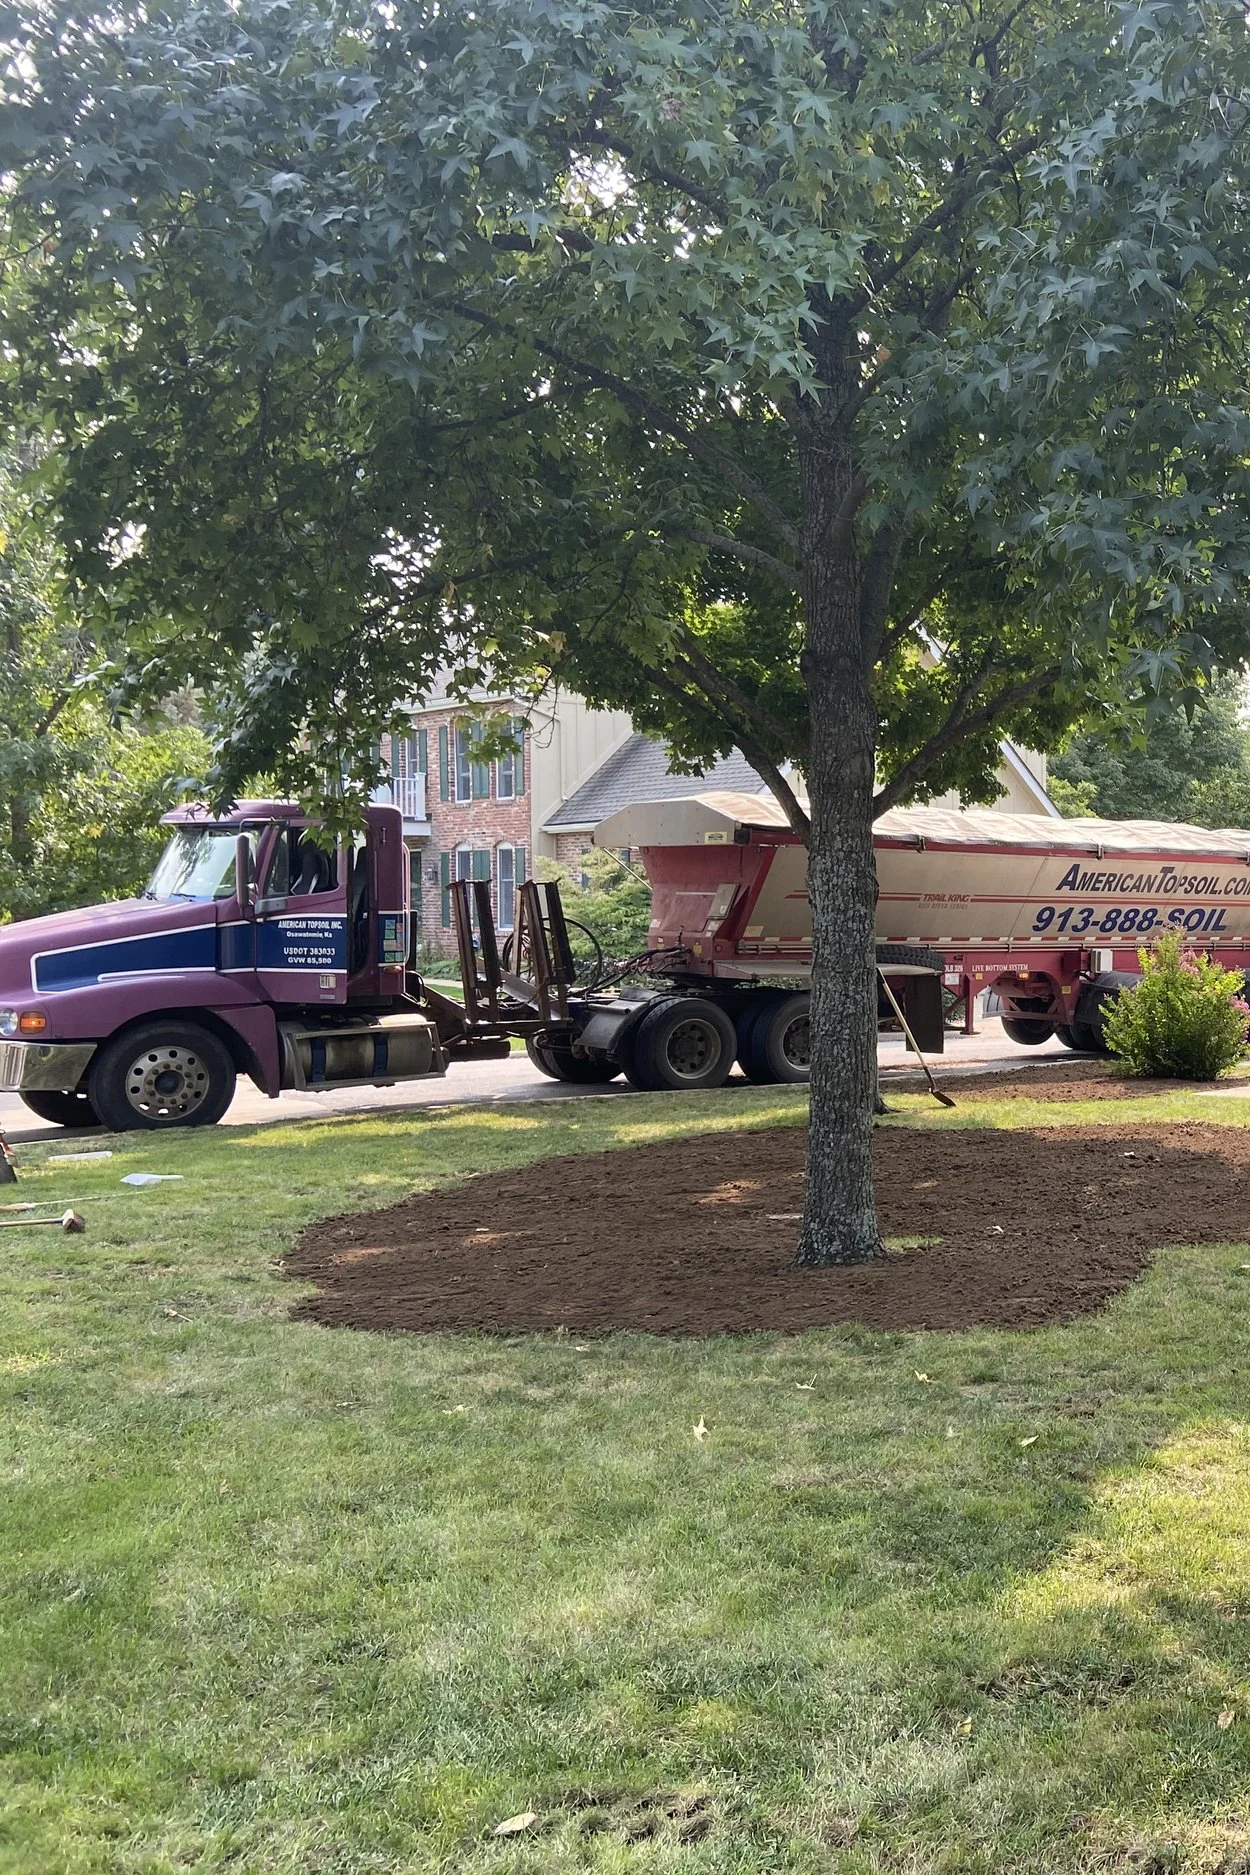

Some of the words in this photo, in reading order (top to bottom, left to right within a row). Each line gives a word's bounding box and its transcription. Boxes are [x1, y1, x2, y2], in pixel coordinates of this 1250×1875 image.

[1032, 906, 1227, 933] 913-888-SOIL
[278, 920, 307, 929] AMERICAN
[307, 920, 330, 929] TOPSOIL
[331, 921, 343, 929] INC.
[283, 947, 308, 955] USDOT
[972, 964, 984, 972] LIVE
[985, 964, 1008, 972] BOTTOM
[1008, 963, 1029, 972] SYSTEM
